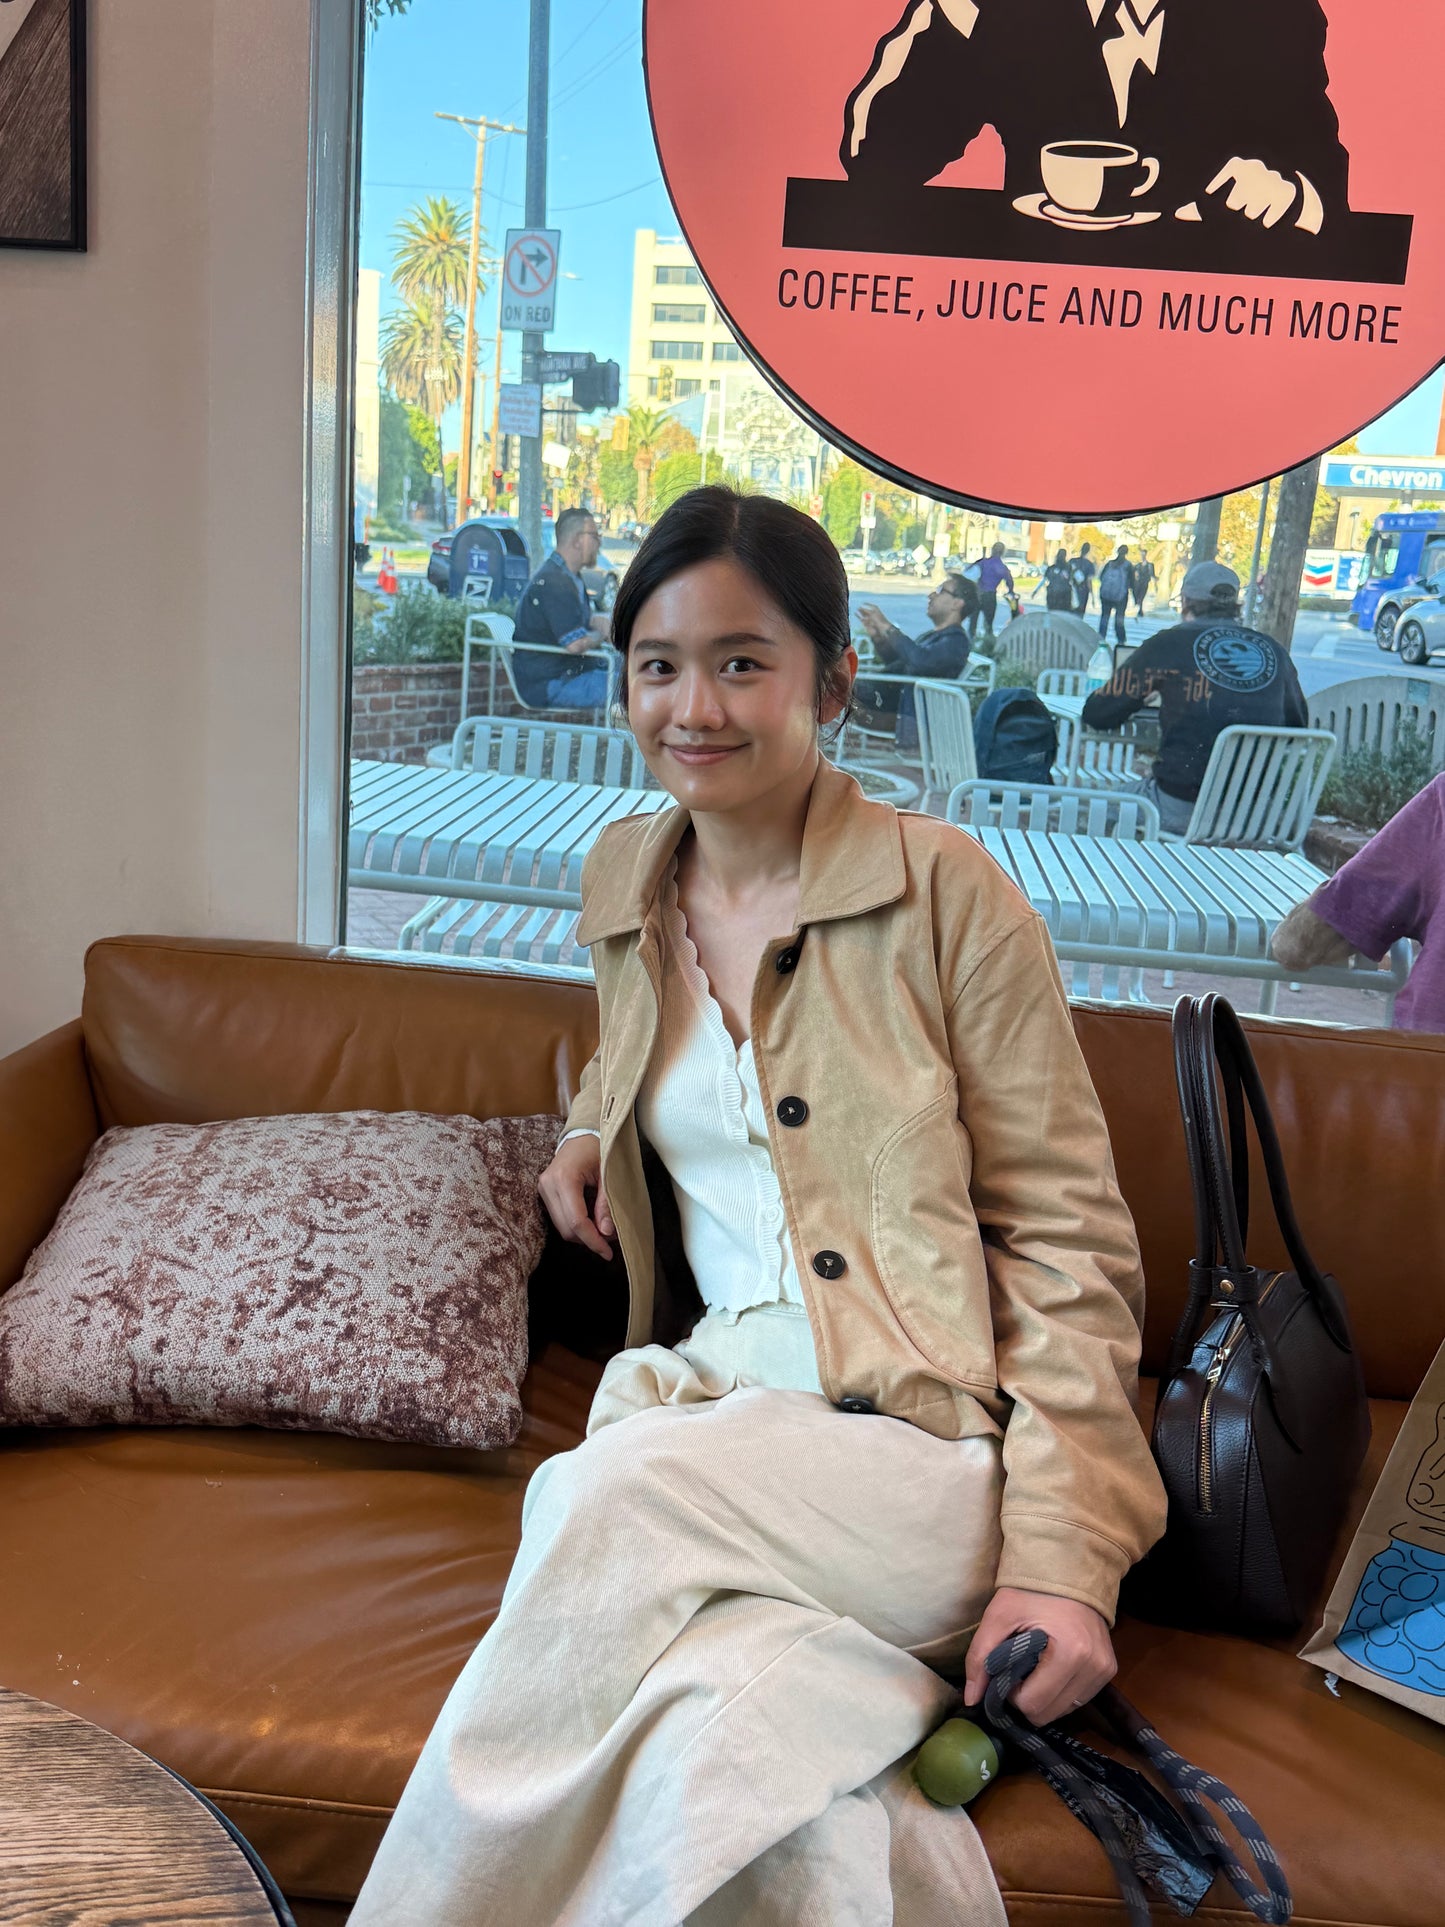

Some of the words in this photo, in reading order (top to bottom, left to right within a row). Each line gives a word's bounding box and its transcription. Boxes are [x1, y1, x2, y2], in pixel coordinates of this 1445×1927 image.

[504, 305, 521, 321] ON
[526, 306, 551, 323] RED
[778, 268, 925, 322] COFFEE,
[936, 279, 1048, 323] JUICE
[1059, 286, 1143, 328] AND
[1158, 291, 1274, 336] MUCH
[1289, 299, 1402, 344] MORE
[1349, 465, 1443, 488] Chevron
